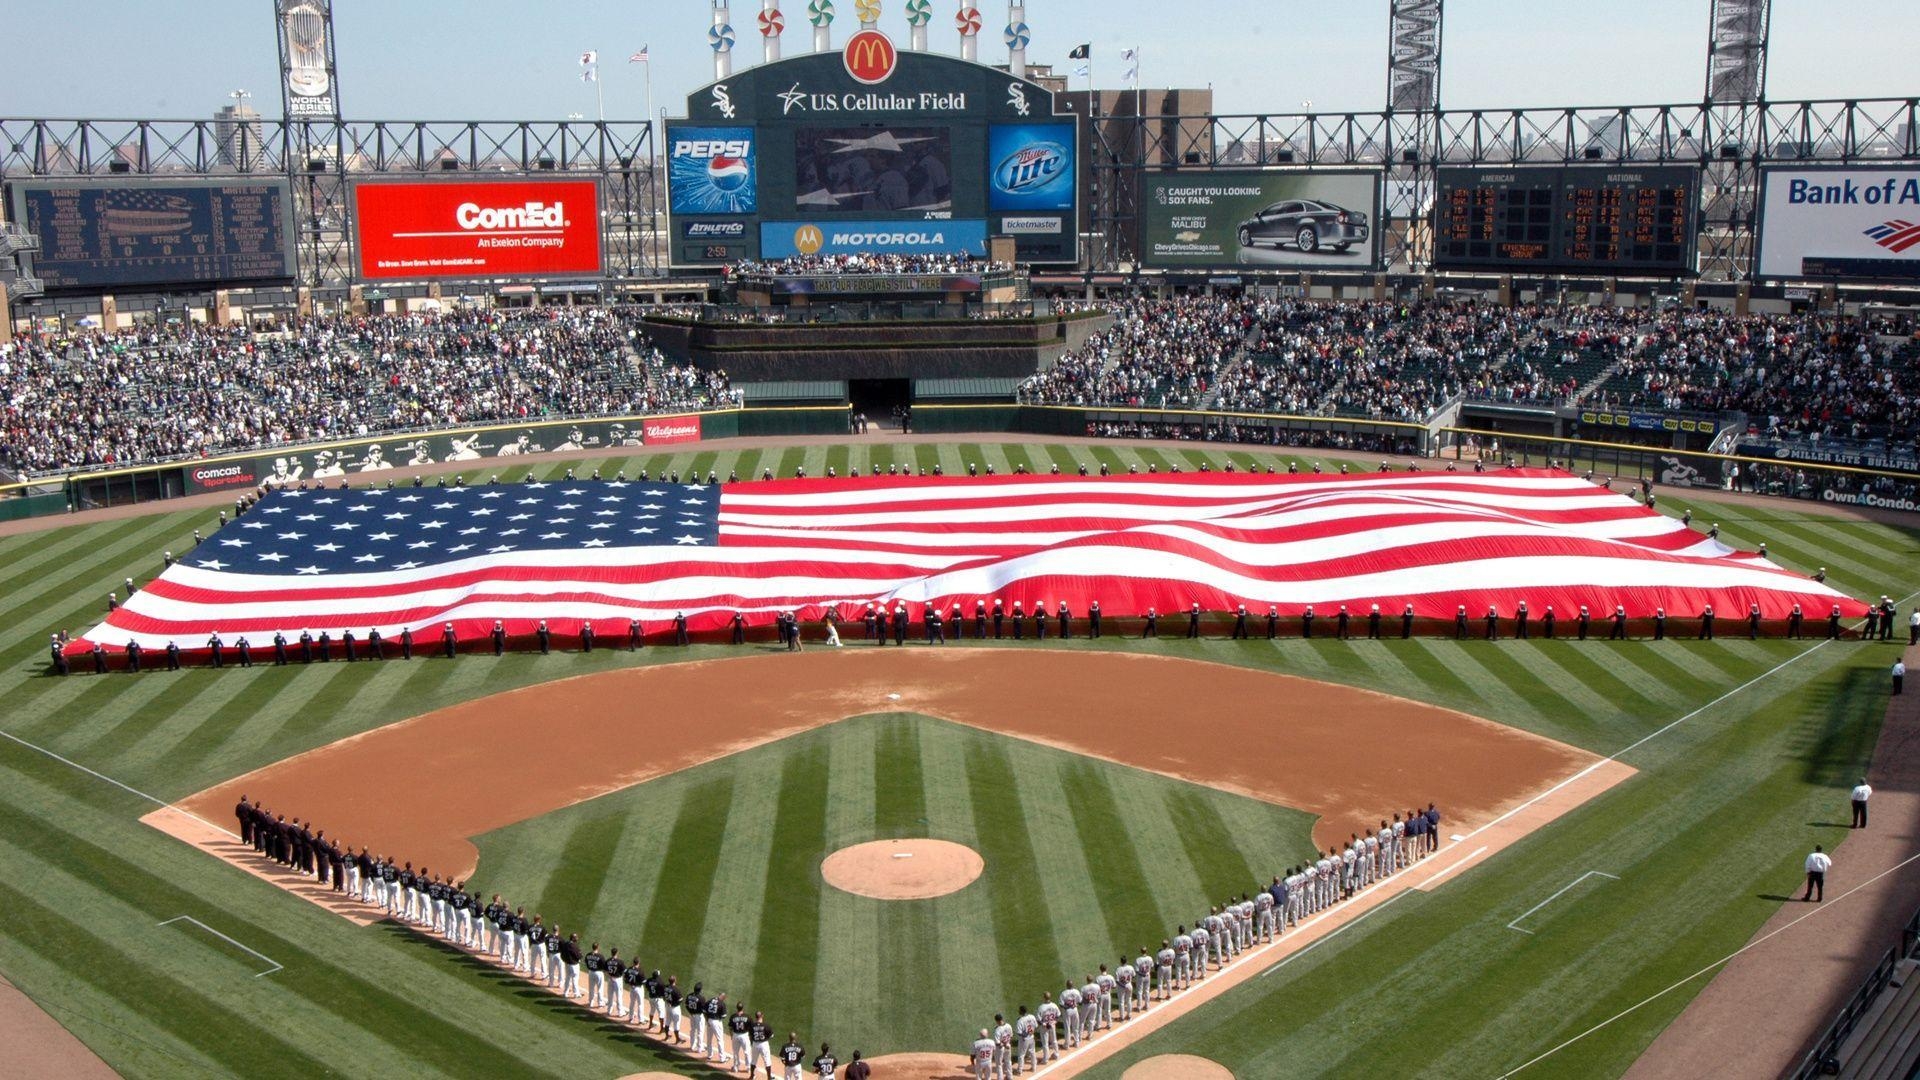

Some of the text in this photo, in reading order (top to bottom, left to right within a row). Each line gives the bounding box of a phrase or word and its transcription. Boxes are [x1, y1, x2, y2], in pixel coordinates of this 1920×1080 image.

[811, 93, 966, 111] U.S. Cellular Field
[674, 141, 750, 158] PEPSI
[1006, 156, 1060, 191] Lite
[1607, 174, 1643, 182] NATIONAL
[1168, 188, 1202, 196] CAUGHT
[1224, 187, 1261, 195] LOOKING
[1788, 179, 1859, 204] Bank
[1864, 179, 1896, 204] of
[1168, 197, 1186, 205] SOX
[456, 202, 563, 230] ComEd
[1007, 221, 1057, 231] ticketmaster
[118, 234, 208, 245] BALL STRIKE OUT
[478, 236, 564, 248] An Exelon Company
[832, 233, 944, 245] MOTOROLA
[707, 246, 727, 257] 2:59
[815, 279, 941, 291] THAT OUR FLAG WAS STILL THERE
[647, 425, 698, 442] Walgreens
[1791, 451, 1832, 462] MILLER
[1835, 455, 1861, 465] LITE
[1868, 457, 1918, 471] BULLPEN
[707, 1003, 718, 1013] 23
[1045, 1013, 1057, 1022] 33
[1026, 1024, 1033, 1034] 2
[820, 1065, 832, 1074] 30
